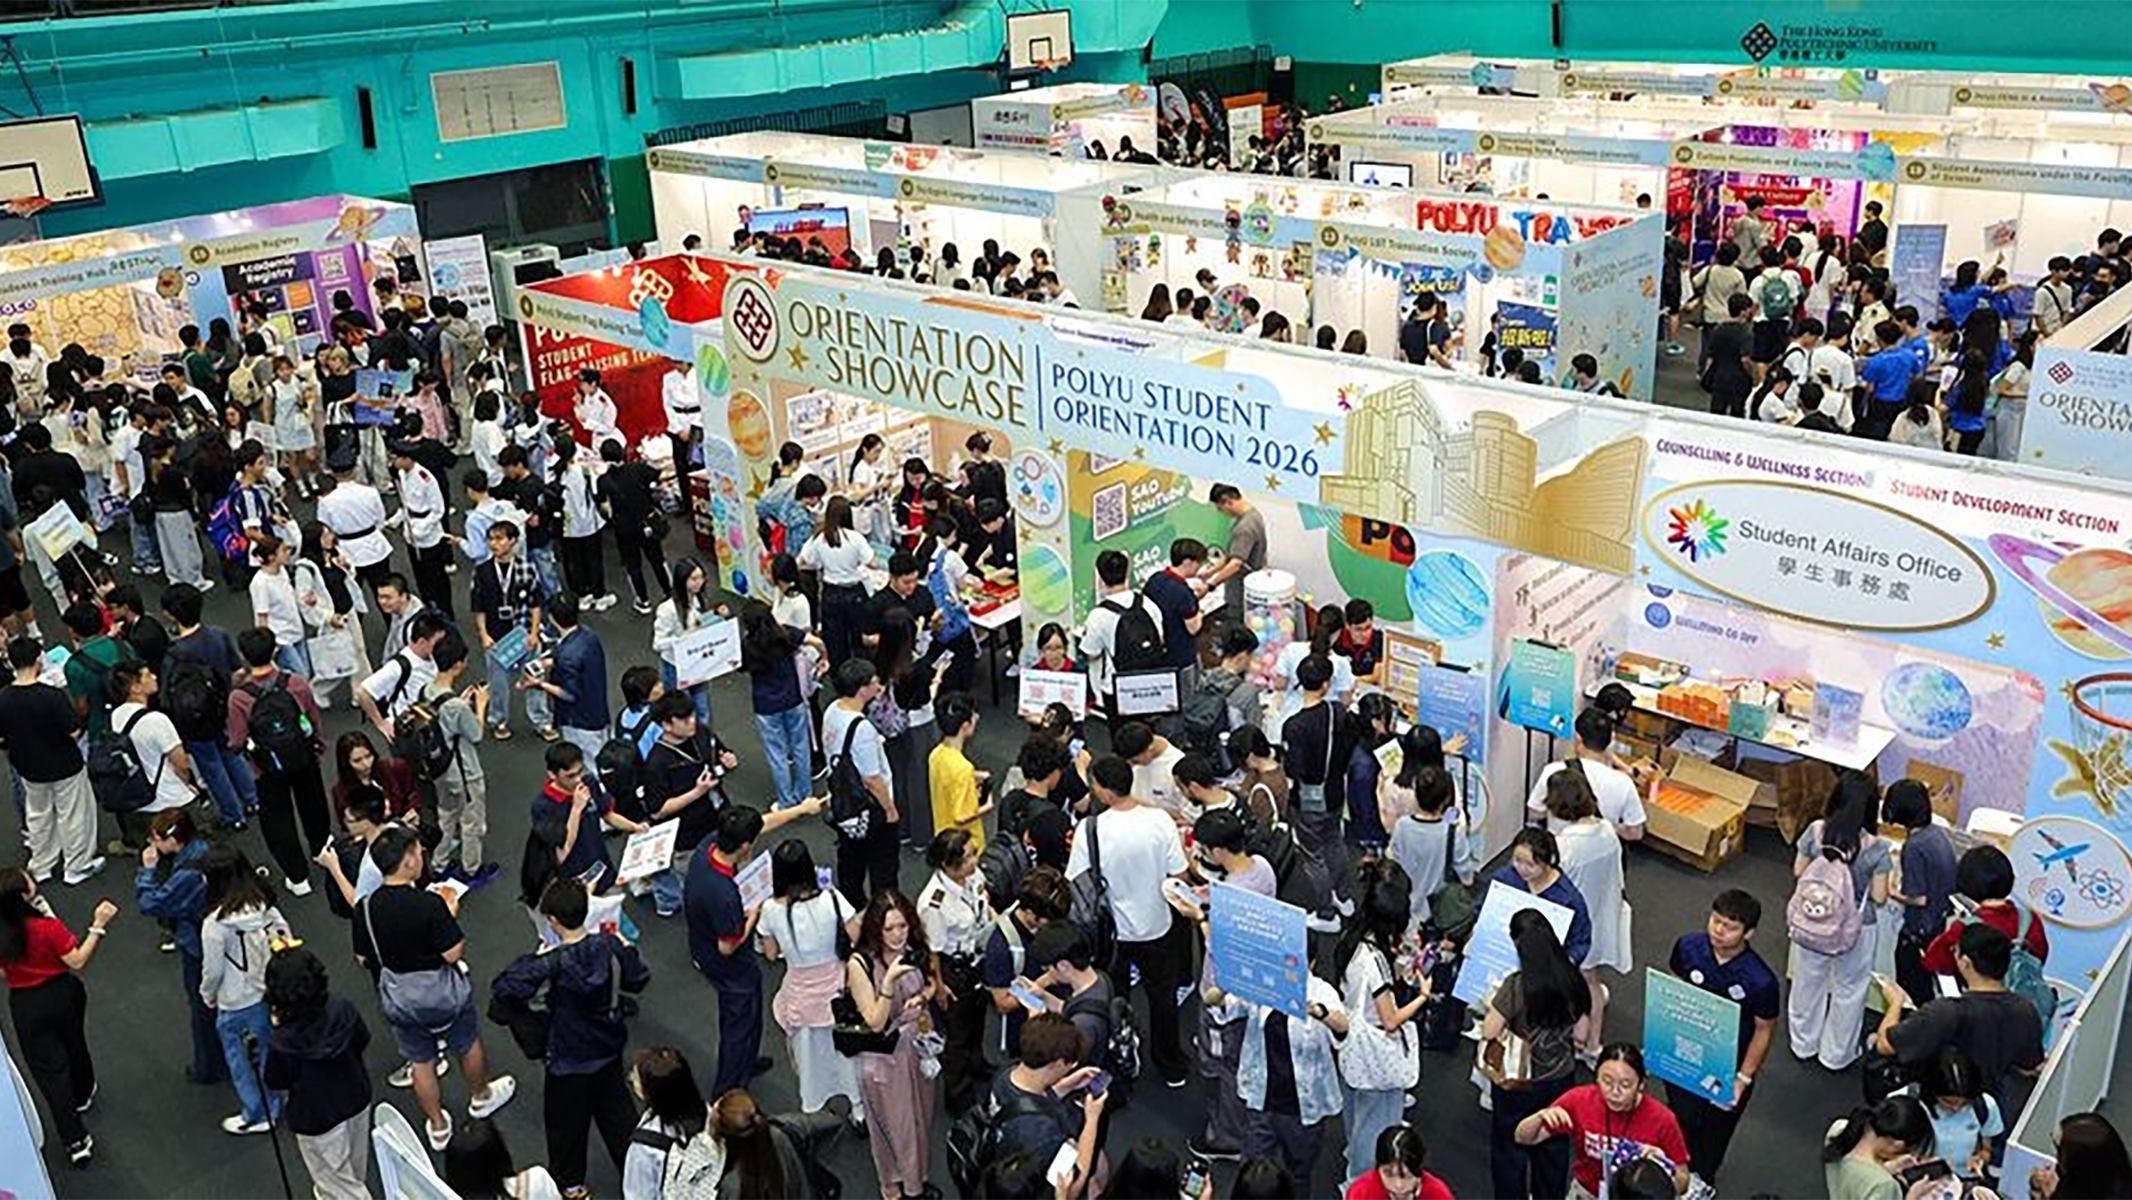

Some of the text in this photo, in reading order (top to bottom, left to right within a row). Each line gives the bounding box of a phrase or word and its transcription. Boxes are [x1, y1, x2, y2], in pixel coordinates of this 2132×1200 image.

[1847, 27, 1883, 38] KONG
[1774, 157, 1791, 167] and
[2072, 171, 2090, 182] the
[1416, 199, 1499, 238] POLYU
[239, 255, 297, 276] Academic
[245, 266, 295, 285] Registry
[537, 342, 593, 370] STUDENT
[788, 299, 1026, 383] ORIENTATION
[826, 345, 1028, 427] SHOWCASE
[1052, 362, 1272, 431] POLYU STUDENT
[1053, 395, 1319, 477] ORIENTATION 2026
[1655, 438, 1731, 465] COUNSELLING
[1733, 451, 1744, 467] &
[1746, 454, 1811, 481] WELLNESS
[1889, 479, 2121, 535] STUDENT DEVELOPMENT SECTION
[1738, 519, 1963, 584] Student Affairs Office
[1776, 555, 1912, 603] 學生事務處
